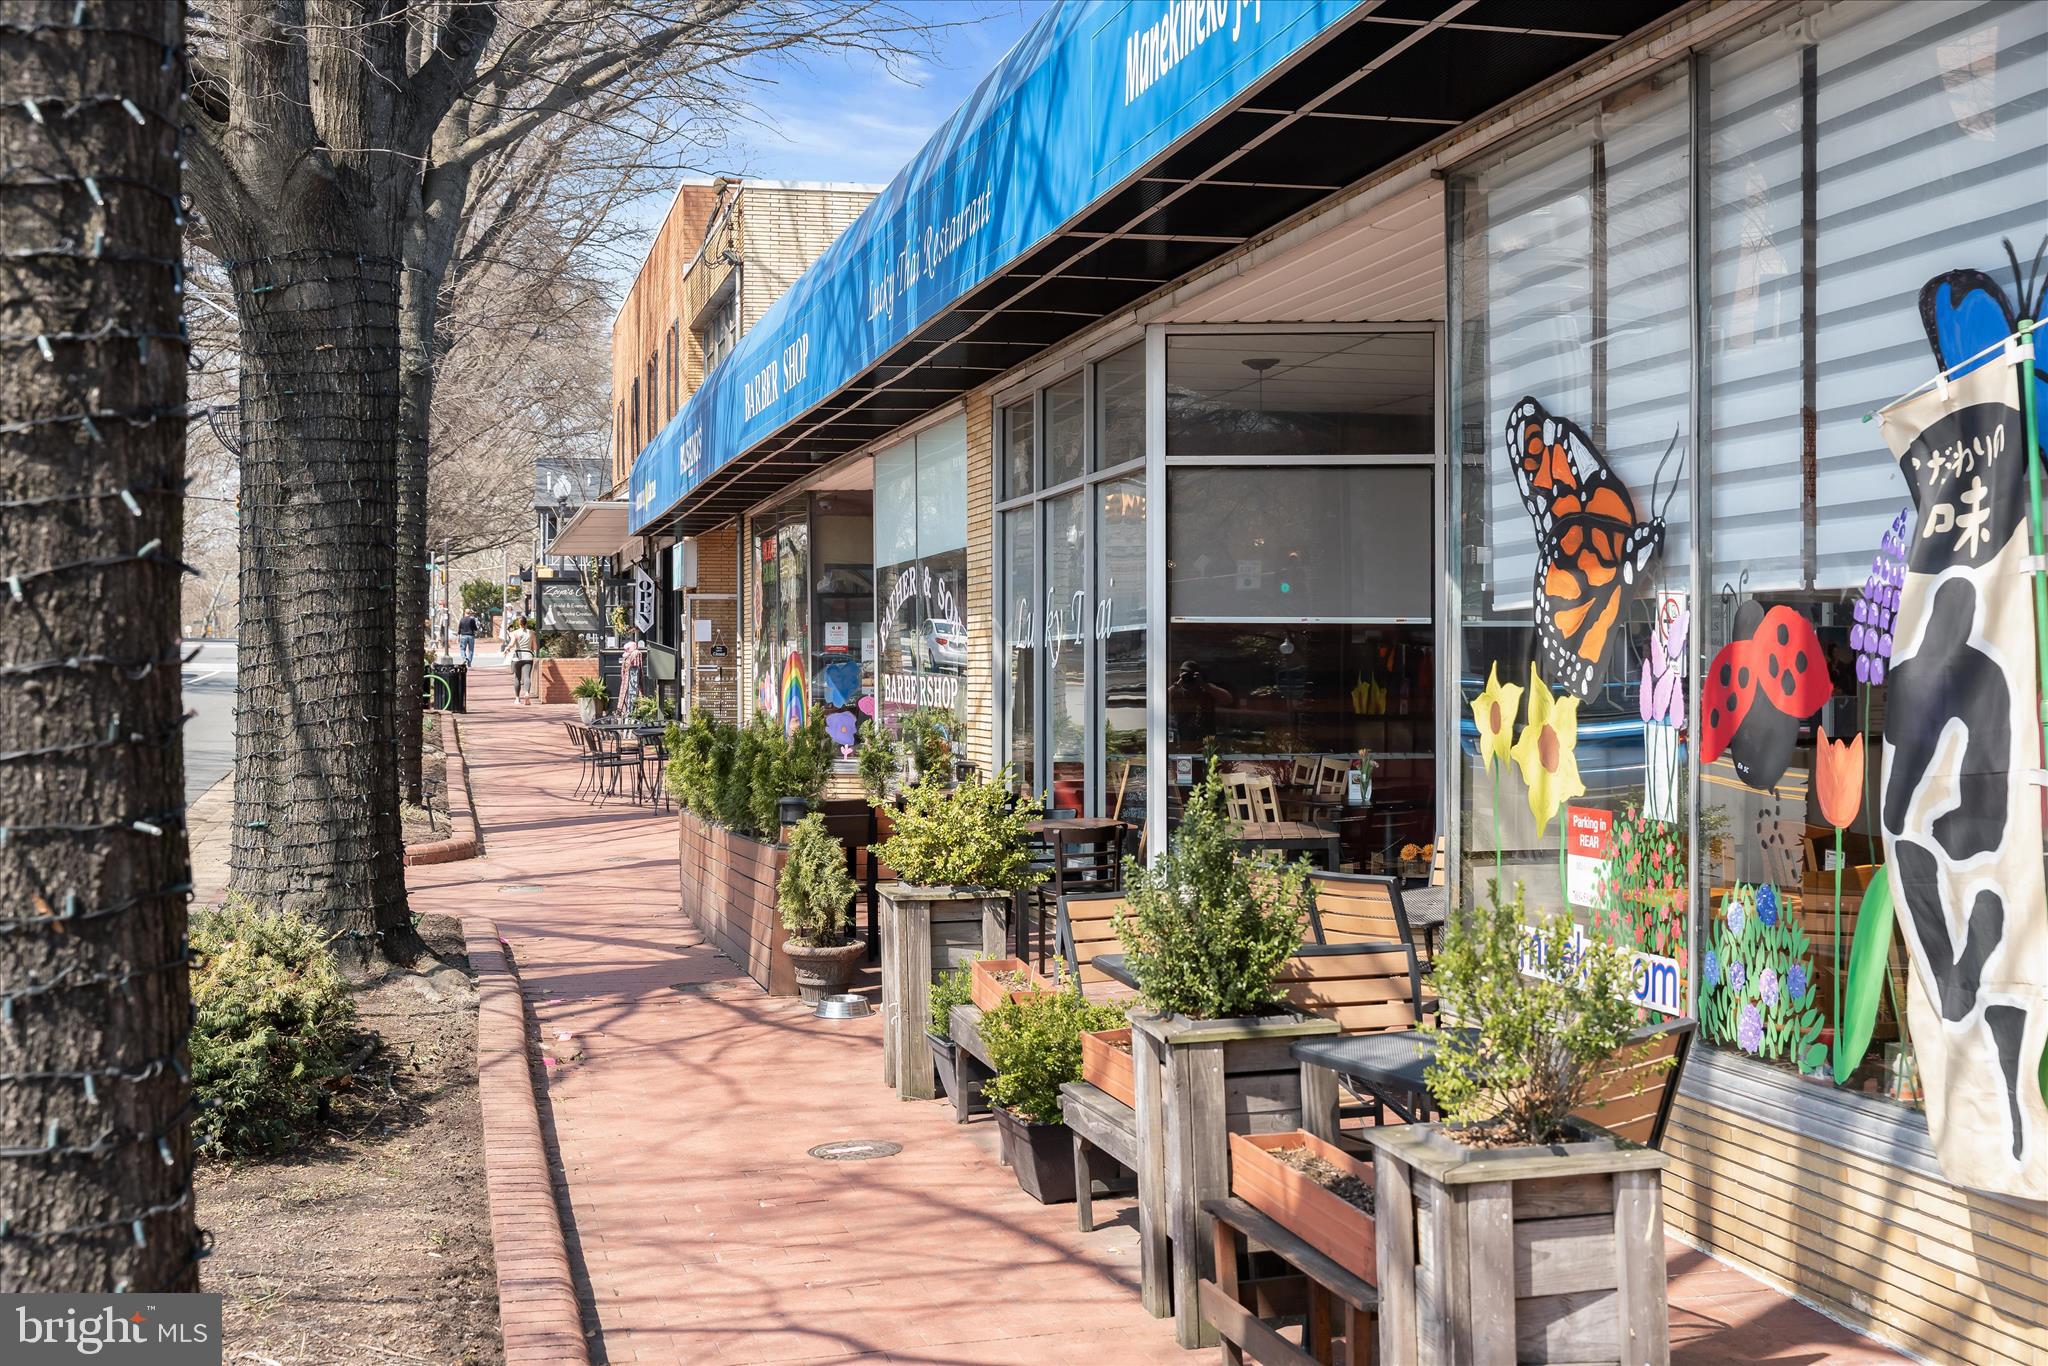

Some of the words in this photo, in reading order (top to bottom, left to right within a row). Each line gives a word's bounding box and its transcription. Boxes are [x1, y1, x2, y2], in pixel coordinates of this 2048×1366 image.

[867, 260, 894, 322] Lucky
[897, 234, 920, 297] Thai
[923, 180, 991, 280] Restaurant
[744, 360, 779, 423] BARBER
[783, 332, 809, 394] SHOP
[1923, 475, 1991, 558] 味
[638, 580, 653, 624] OPEN
[880, 566, 917, 653] FATHER
[923, 565, 932, 599] &
[1016, 586, 1064, 670] Luky
[1071, 577, 1114, 645] Tai
[884, 673, 958, 709] BARBERSHOP
[1573, 815, 1599, 833] Parking
[1600, 818, 1607, 831] in
[1579, 834, 1600, 849] REAR
